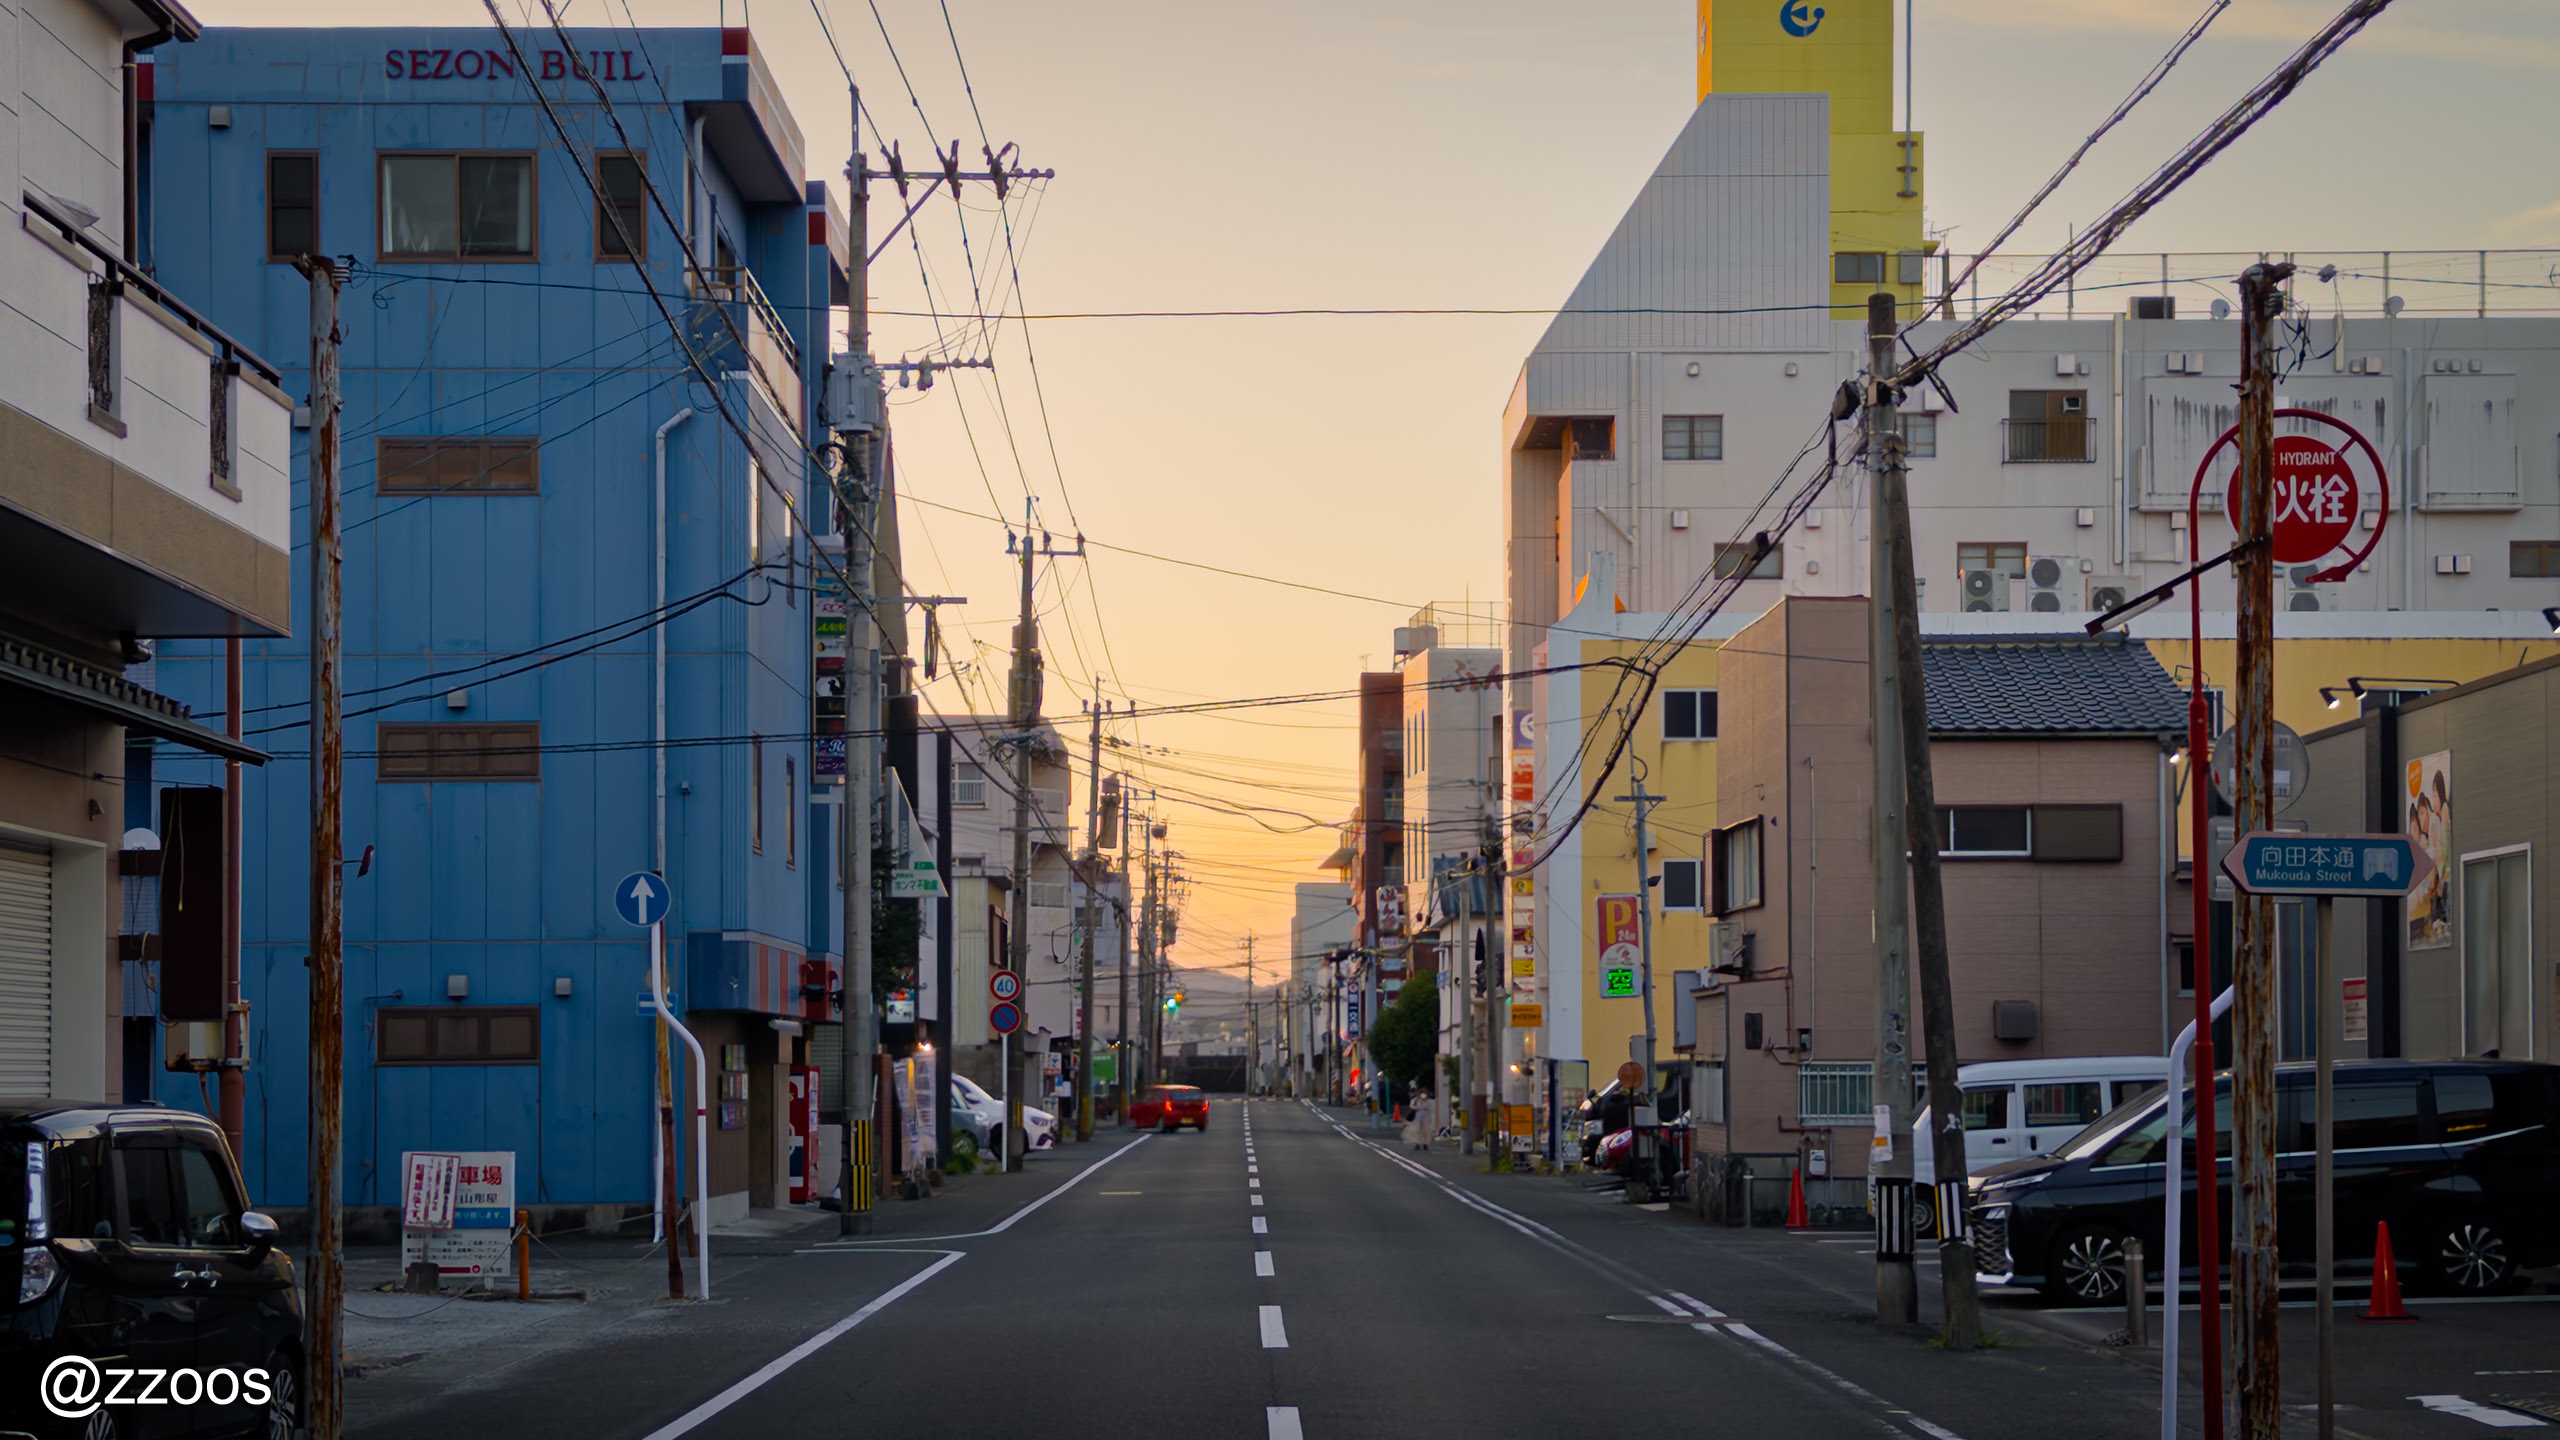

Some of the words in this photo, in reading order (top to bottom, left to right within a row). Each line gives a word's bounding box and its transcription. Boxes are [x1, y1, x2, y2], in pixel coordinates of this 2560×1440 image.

[385, 49, 516, 80] SEZON
[540, 49, 645, 81] BUIL
[2279, 451, 2336, 466] HYDRANT
[2273, 473, 2350, 524] 火栓
[2261, 845, 2355, 868] 向田本通
[2255, 867, 2312, 881] Mukouda
[2316, 869, 2352, 882] Street
[1605, 900, 1632, 945] P
[996, 978, 1015, 993] 40
[459, 1165, 503, 1186] 車場
[459, 1192, 498, 1205] 山形屋
